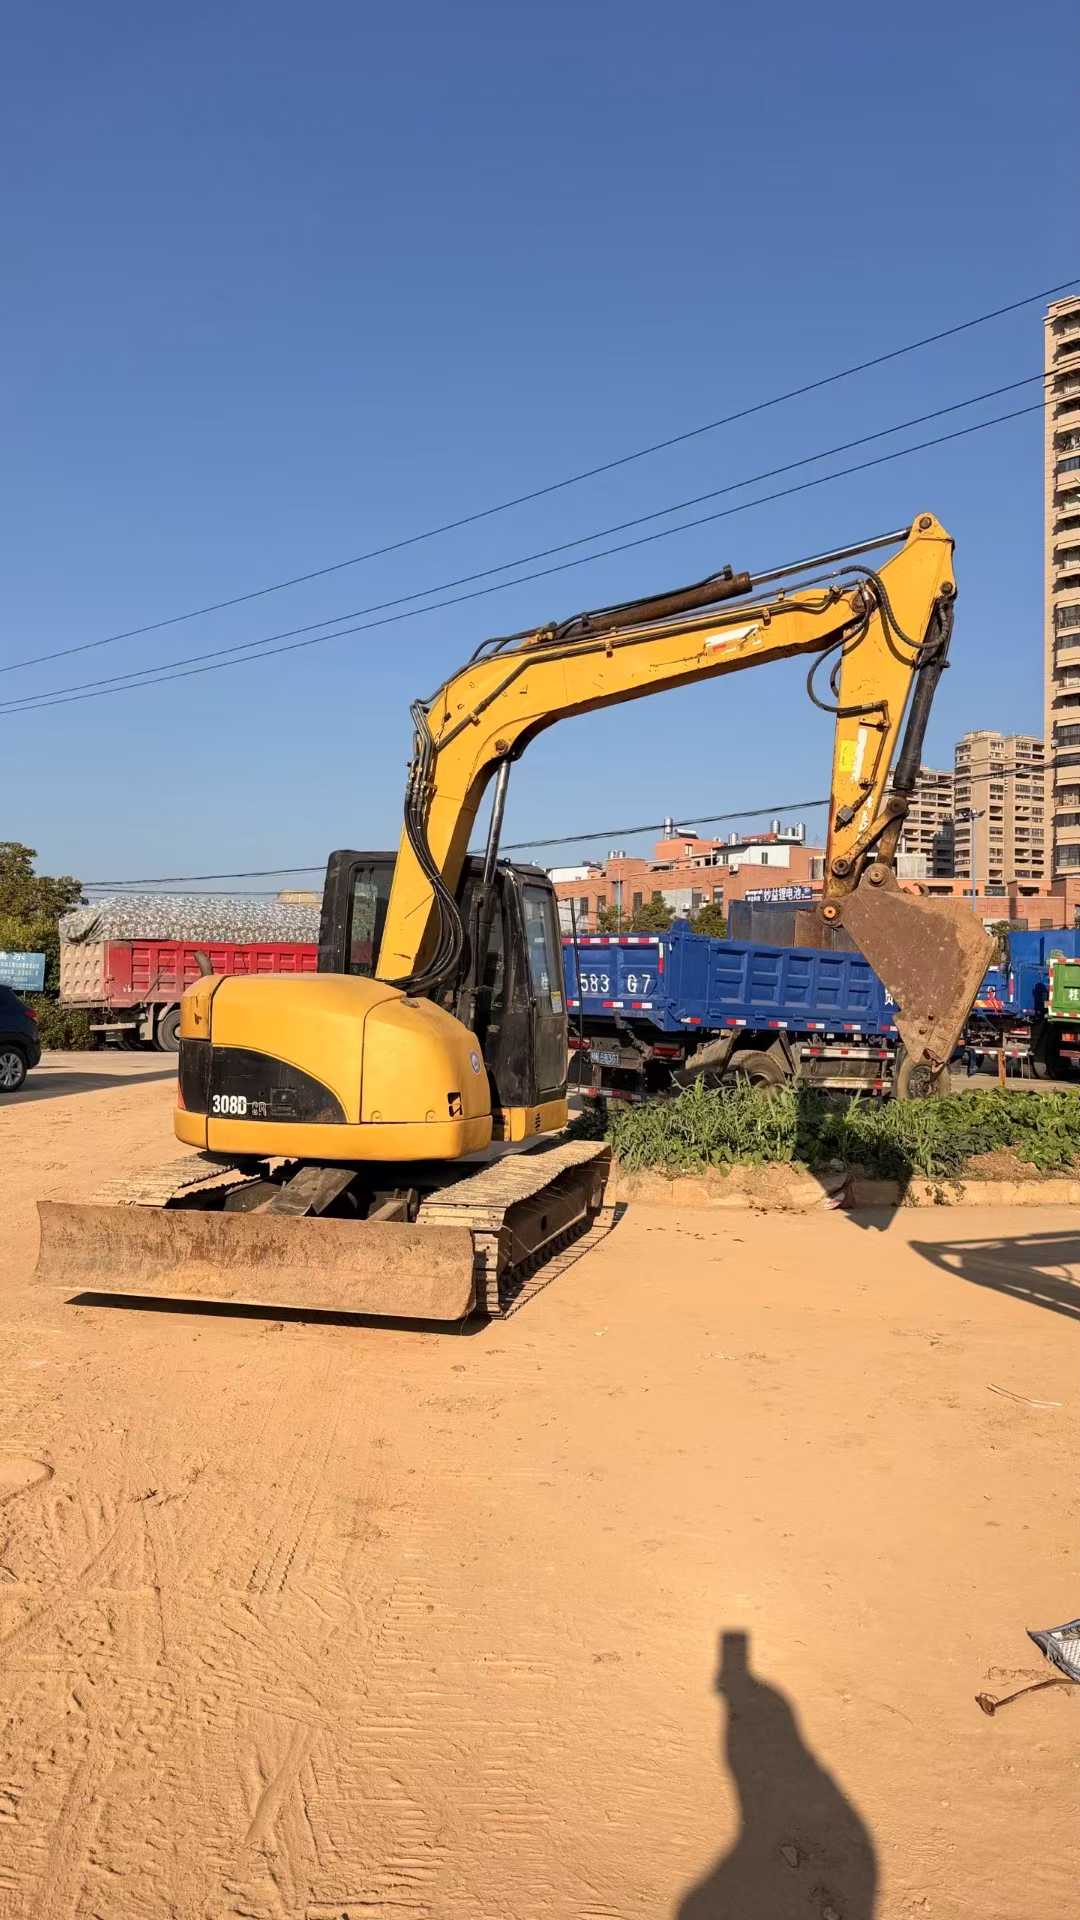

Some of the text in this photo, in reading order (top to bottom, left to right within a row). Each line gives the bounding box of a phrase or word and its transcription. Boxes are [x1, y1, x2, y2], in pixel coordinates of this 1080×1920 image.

[580, 973, 651, 993] 583 G7
[212, 1094, 247, 1115] 308D
